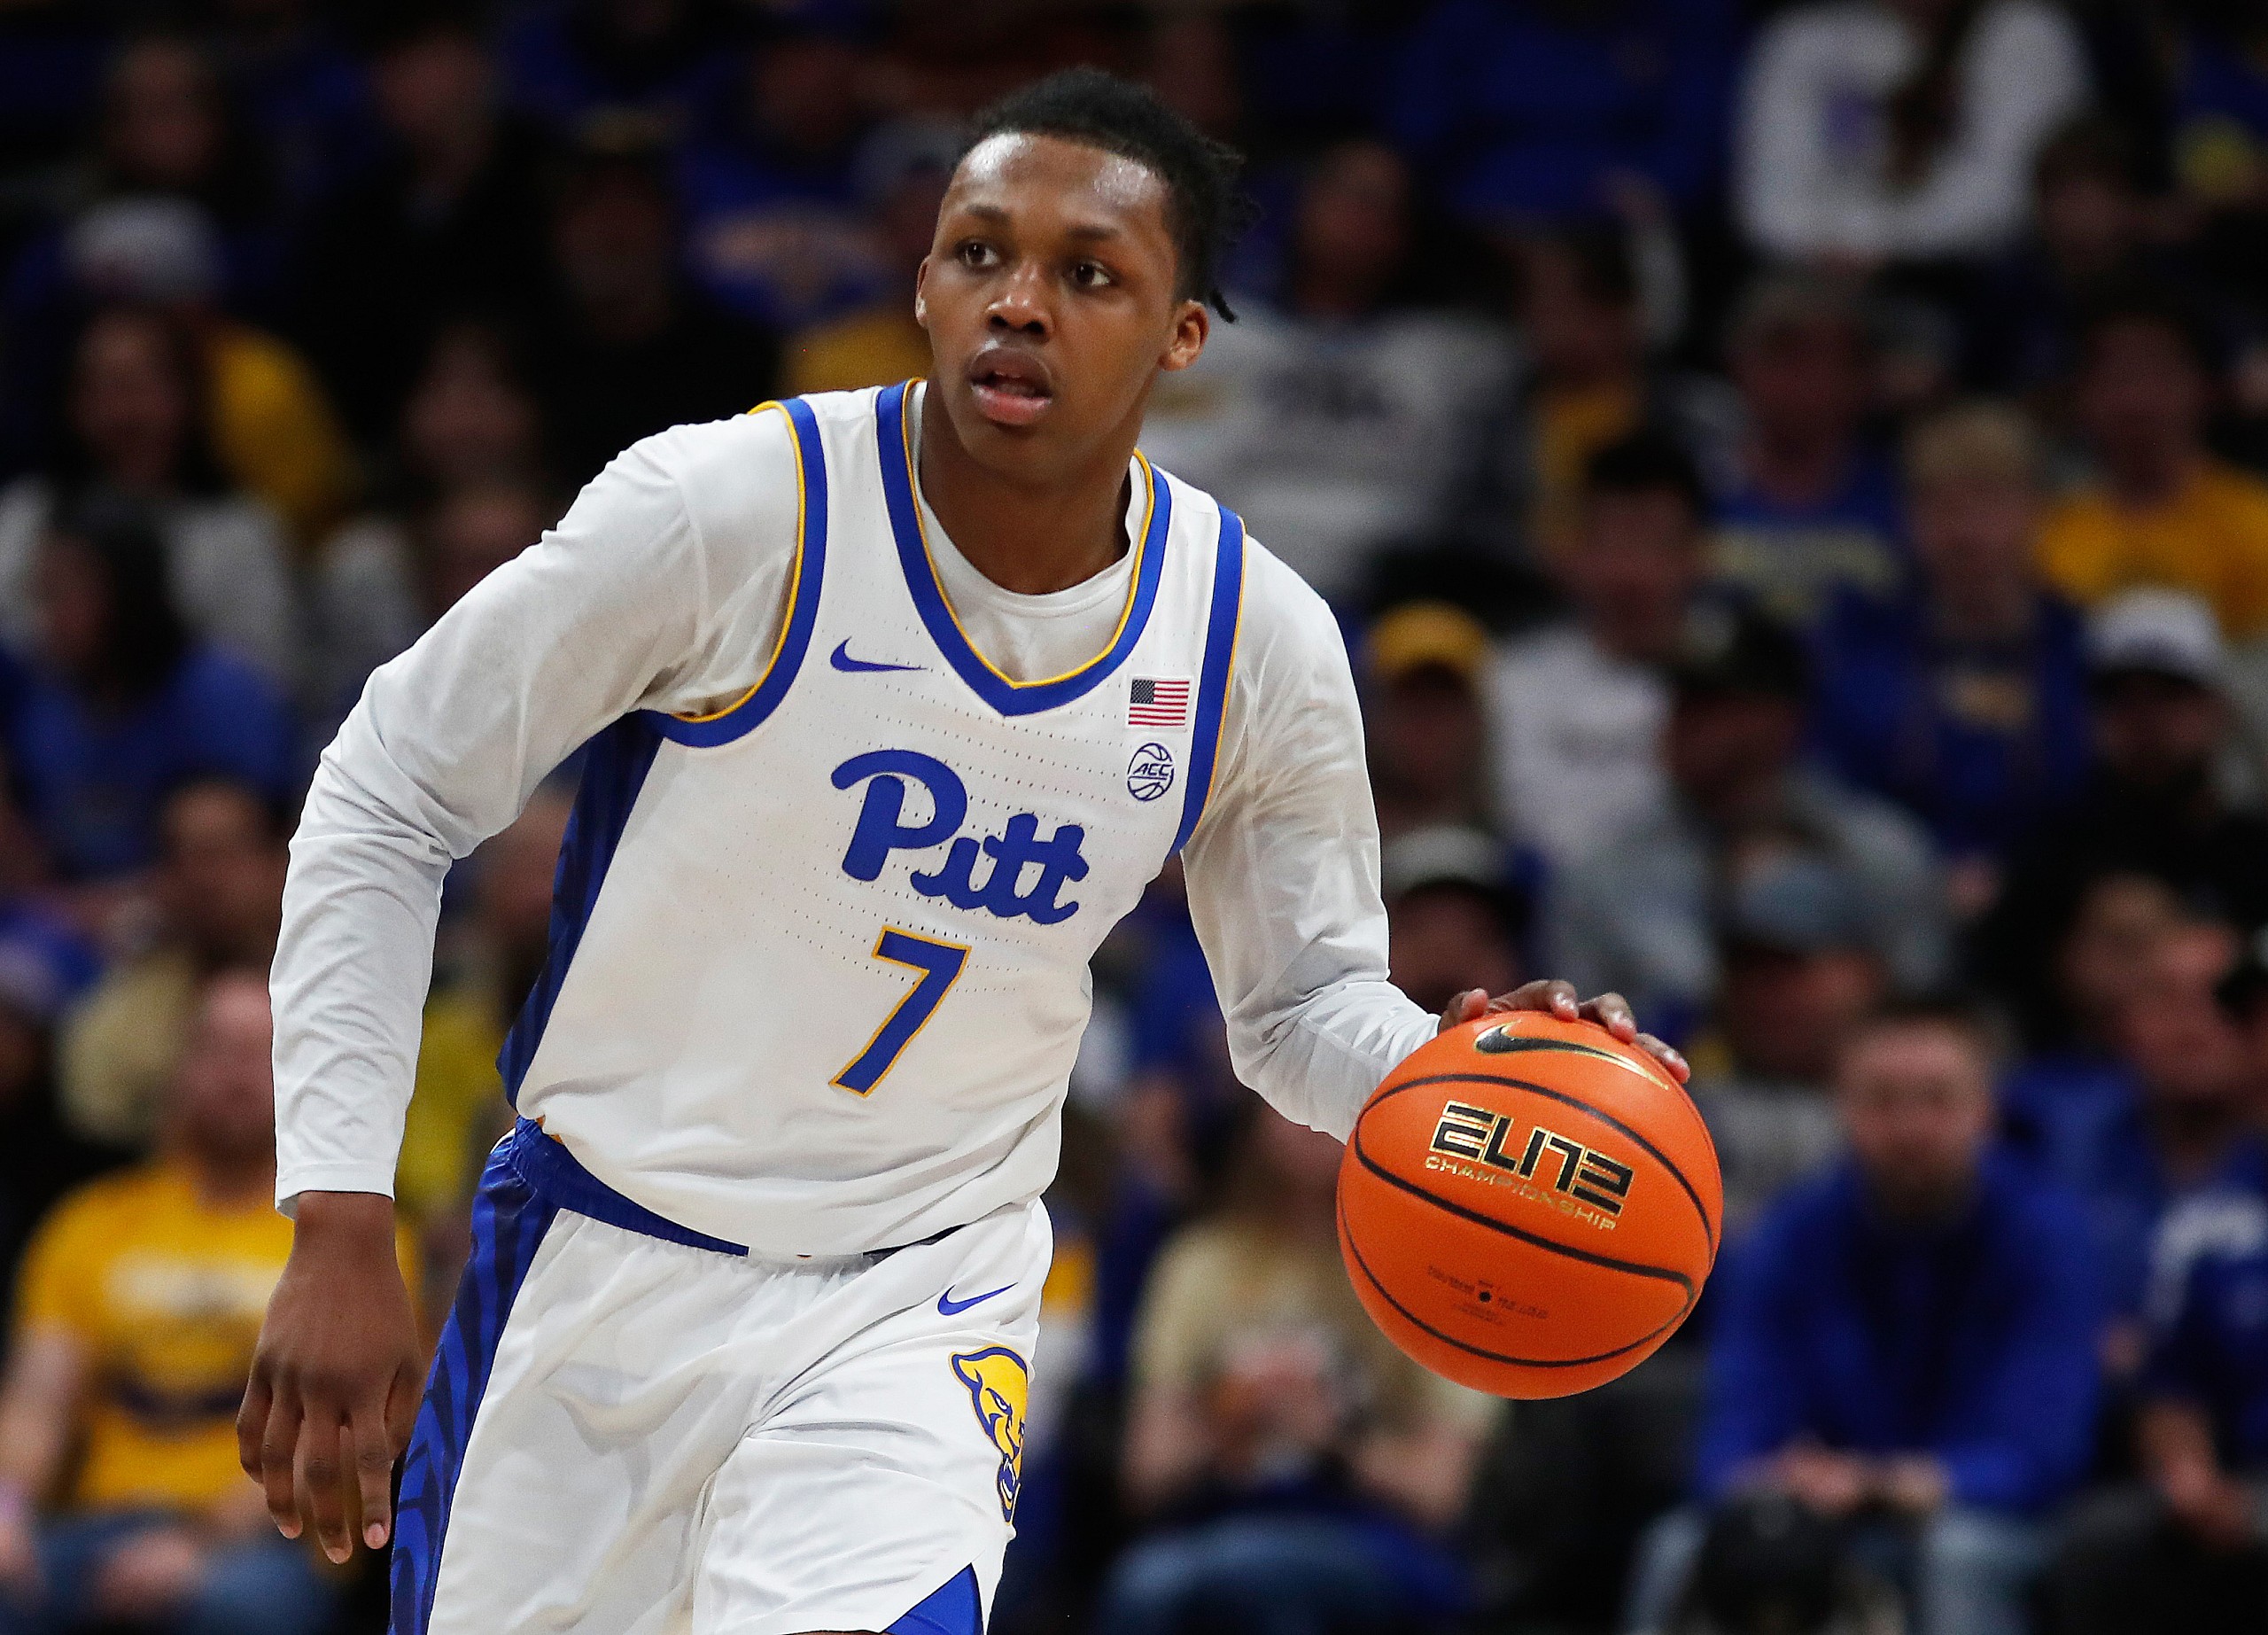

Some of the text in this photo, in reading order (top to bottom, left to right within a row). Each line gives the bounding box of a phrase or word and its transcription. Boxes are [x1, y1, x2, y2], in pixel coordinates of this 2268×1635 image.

[1133, 763, 1173, 776] ACC
[830, 749, 1090, 925] Pitt
[828, 925, 972, 1098] 7
[1425, 1156, 1618, 1231] CHAMPIONSHIP
[1429, 1100, 1635, 1217] ELITE
